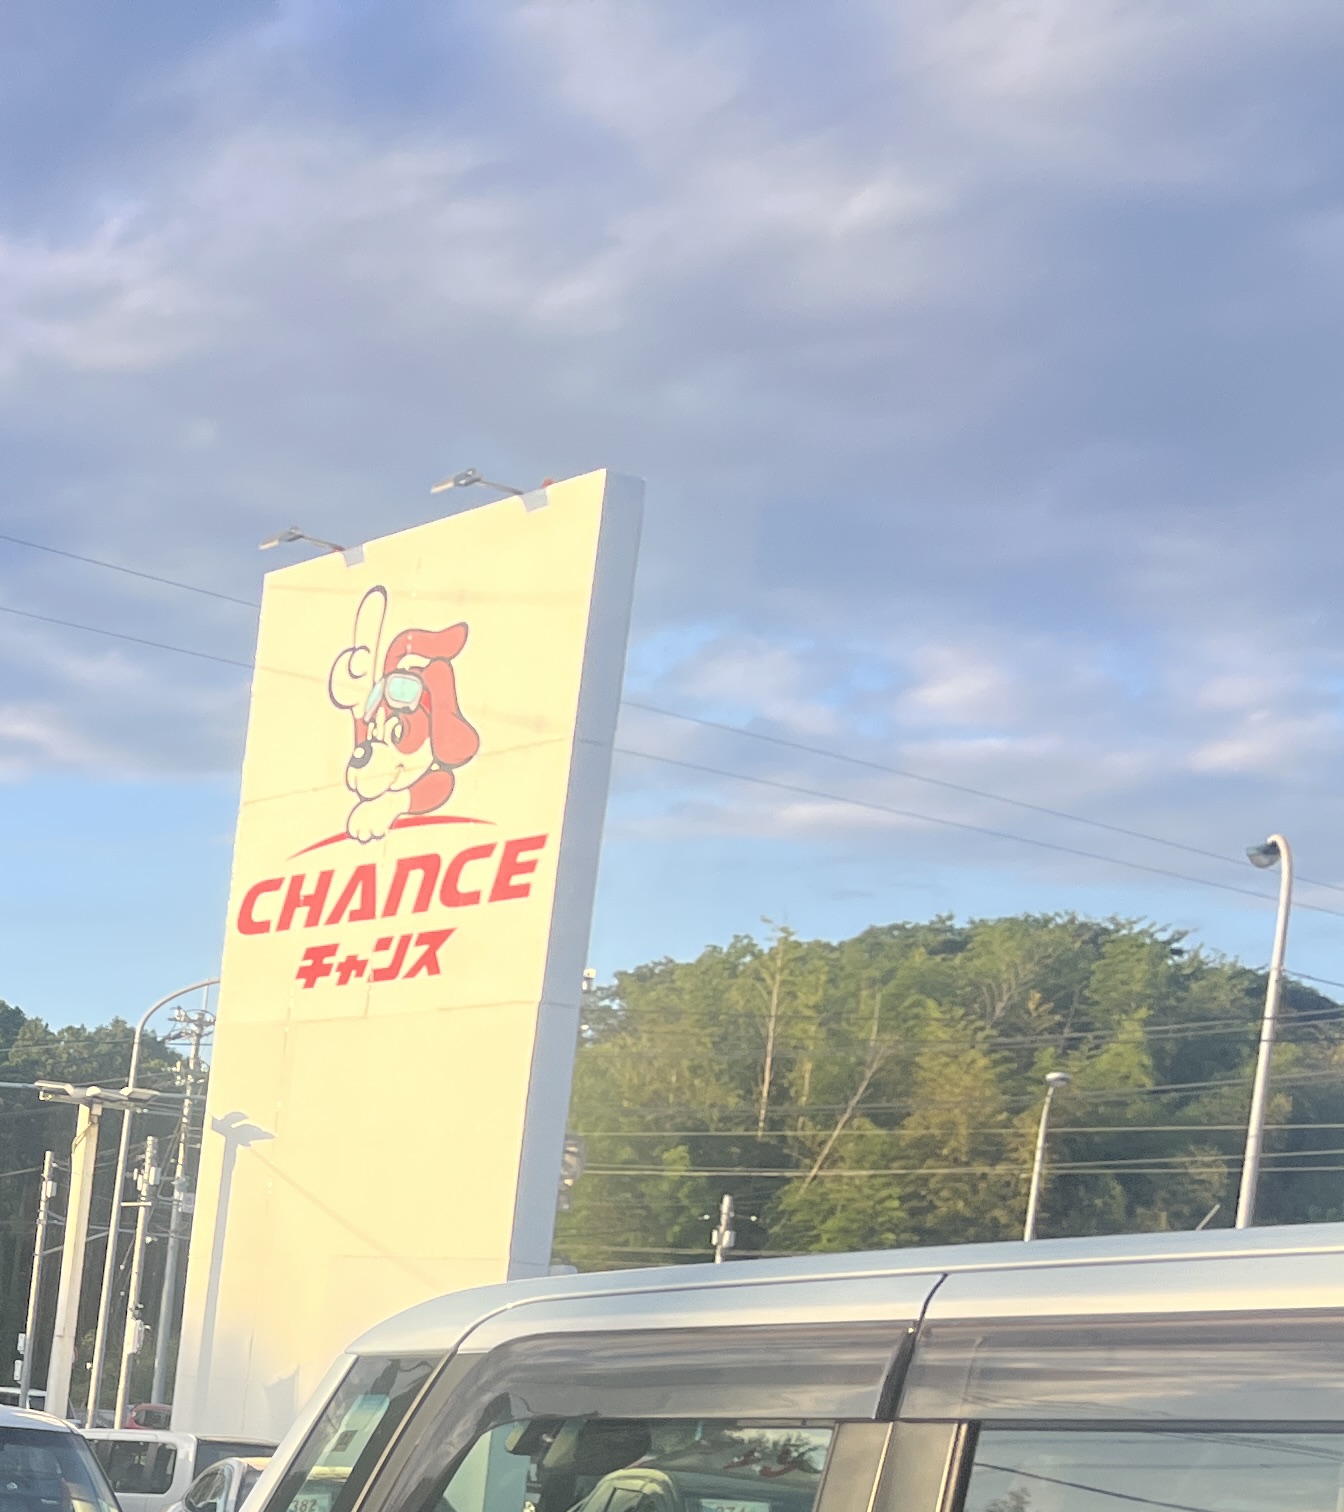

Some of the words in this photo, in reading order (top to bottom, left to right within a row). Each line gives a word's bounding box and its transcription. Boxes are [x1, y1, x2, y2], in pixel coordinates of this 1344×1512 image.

[237, 833, 549, 936] CHANCE
[295, 927, 457, 989] チャンス
